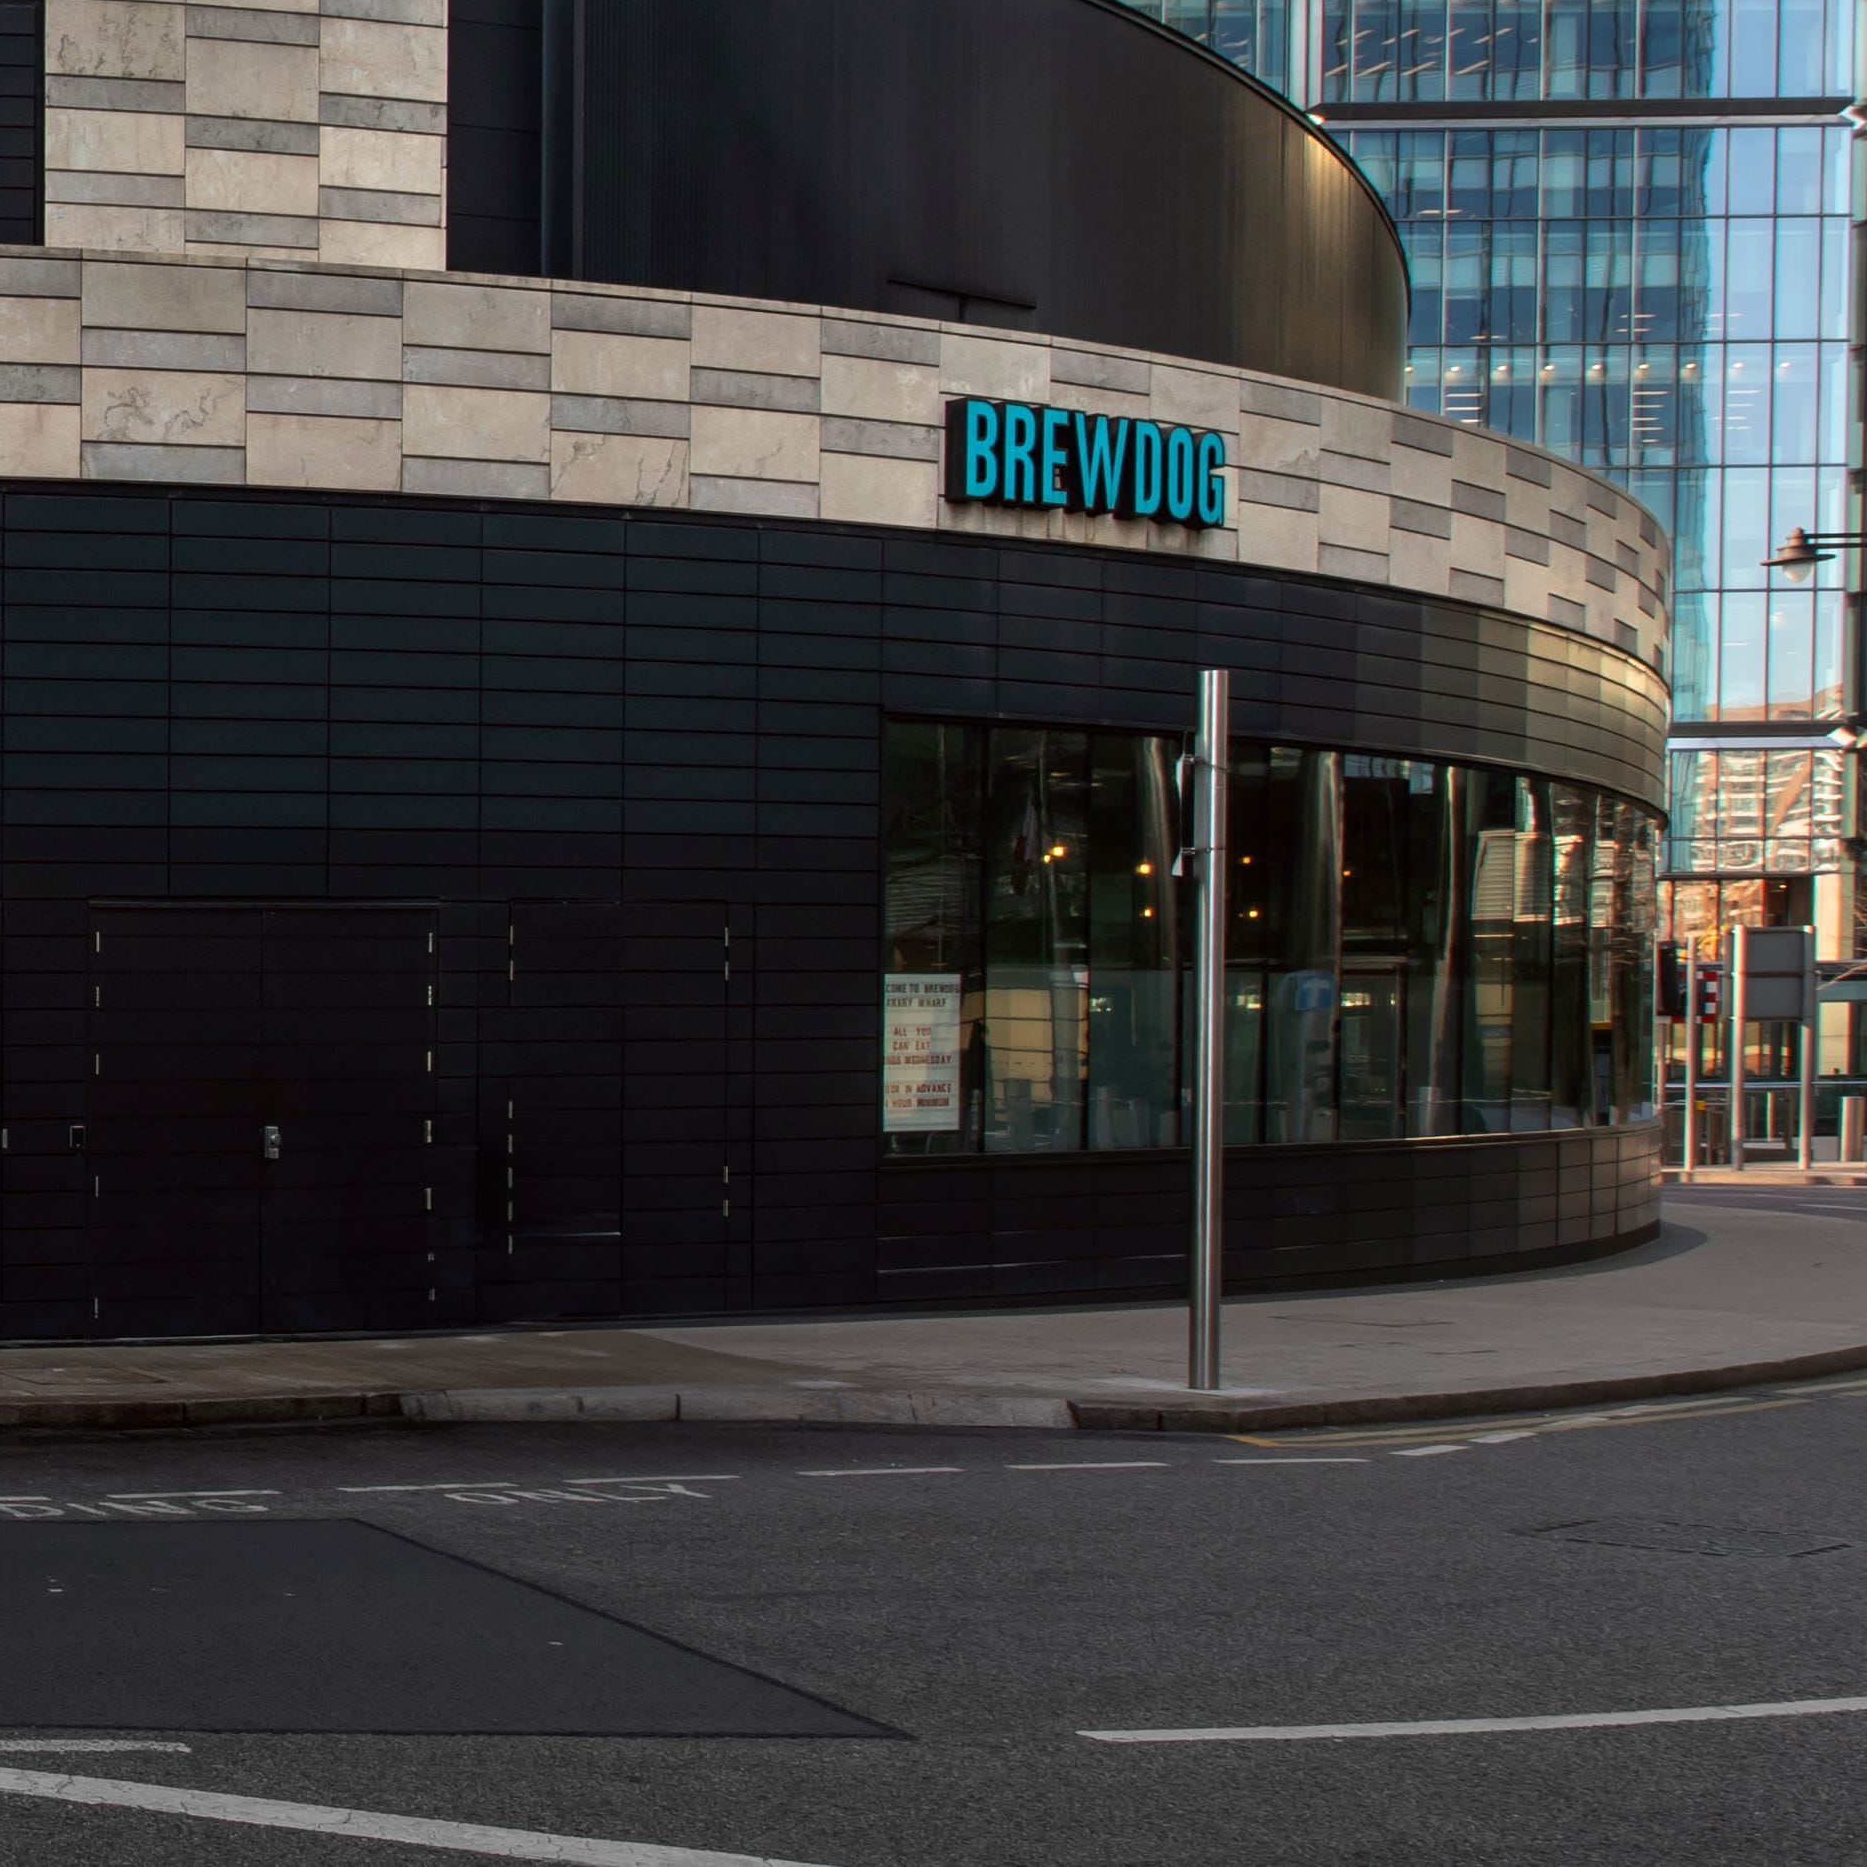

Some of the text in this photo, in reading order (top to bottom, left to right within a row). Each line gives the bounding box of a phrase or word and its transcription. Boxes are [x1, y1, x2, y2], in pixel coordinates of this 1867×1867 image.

[964, 398, 1226, 527] BREWDOG
[909, 983, 919, 993] TO
[924, 983, 960, 993] BREWDOG
[918, 998, 946, 1007] WHARF
[893, 1027, 931, 1036] ALL YOU
[893, 1041, 931, 1050] CAN EAT
[904, 1055, 951, 1065] WEDNESDAY
[916, 1083, 952, 1093] ADVANCE
[892, 1098, 912, 1107] HOUR
[916, 1097, 950, 1107] MINIMUM
[444, 1483, 713, 1505] ONLY
